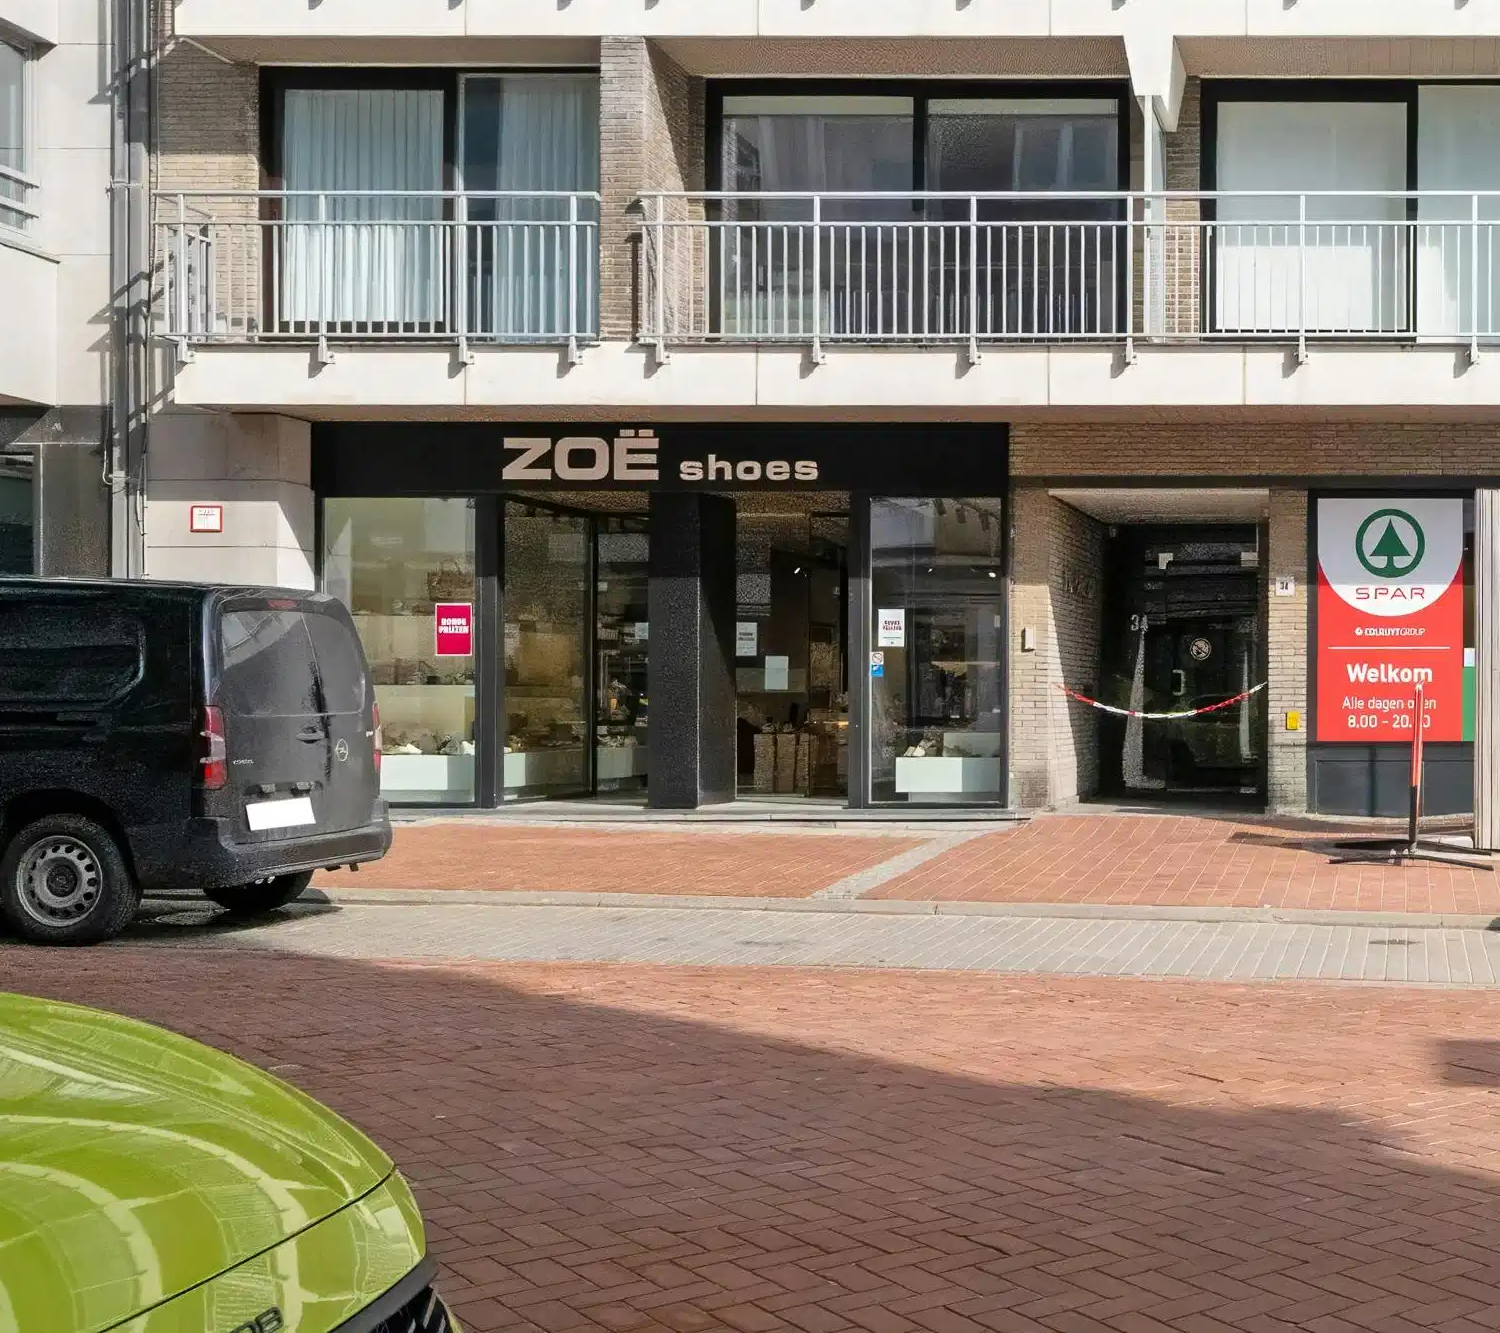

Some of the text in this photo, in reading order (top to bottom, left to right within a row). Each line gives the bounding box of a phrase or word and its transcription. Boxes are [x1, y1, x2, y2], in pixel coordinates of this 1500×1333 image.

[502, 429, 819, 481] ZOË shoes
[1356, 587, 1425, 600] SPAR
[1346, 663, 1433, 683] Welkom
[1342, 696, 1436, 713] Alle dagen oen
[1348, 715, 1378, 728] 8.00
[1392, 715, 1431, 728] 20.0
